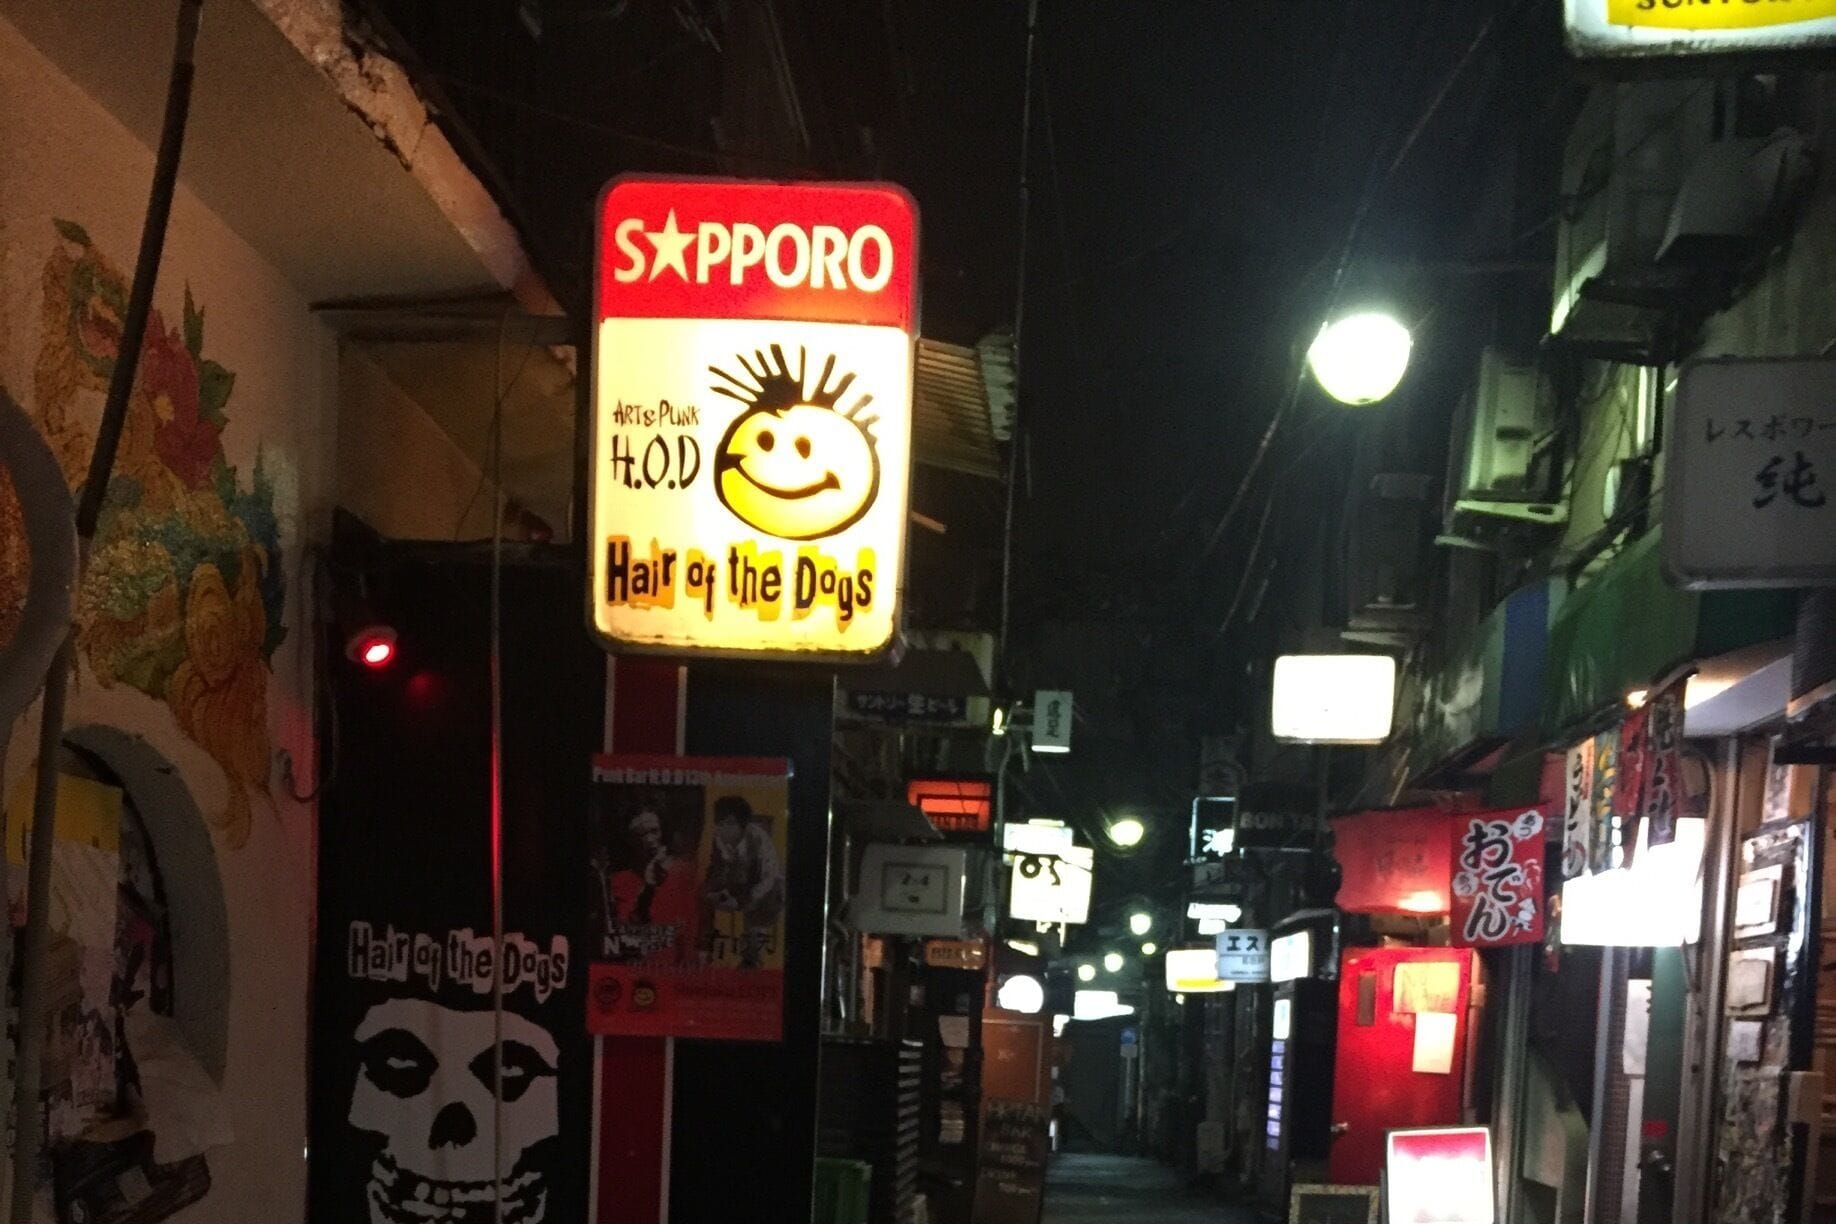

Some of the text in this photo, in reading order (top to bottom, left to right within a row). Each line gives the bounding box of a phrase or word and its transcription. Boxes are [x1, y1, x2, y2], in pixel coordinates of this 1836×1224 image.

[610, 434, 700, 489] H.O.D
[606, 540, 873, 622] Hair of the Dogs
[1462, 821, 1521, 941] おでん
[350, 922, 408, 981] Hair
[415, 934, 440, 992] of
[448, 928, 495, 992] the
[502, 933, 568, 1002] Dogs
